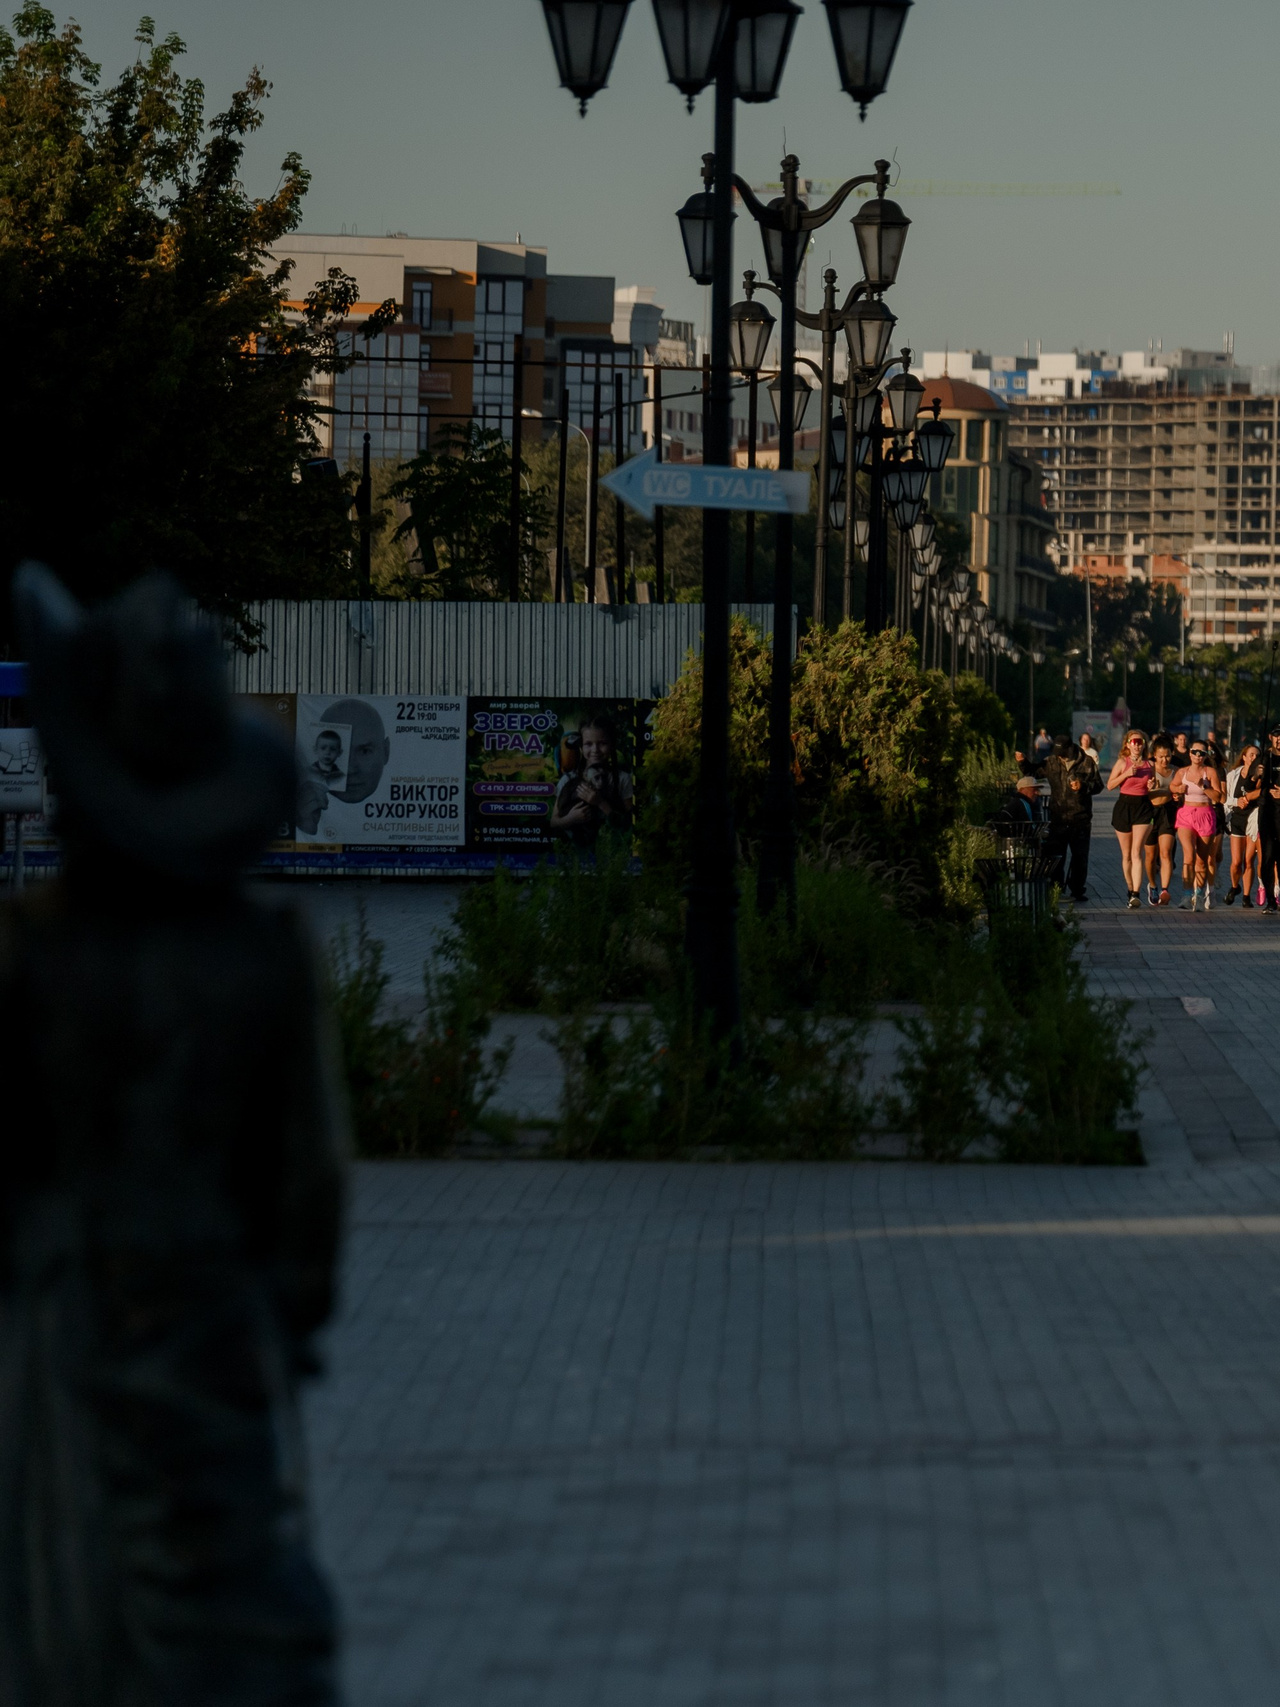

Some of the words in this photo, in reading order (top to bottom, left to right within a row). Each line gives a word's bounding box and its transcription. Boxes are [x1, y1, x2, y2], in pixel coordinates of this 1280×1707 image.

[648, 471, 689, 497] WC
[703, 475, 784, 501] ТУАЛЕ
[396, 702, 415, 720] 22
[417, 702, 460, 711] СЕНТЯБРЯ
[489, 702, 507, 710] мир
[509, 701, 540, 710] зверей
[417, 712, 437, 721] 19:00
[473, 711, 552, 732] ЗВЕРО
[395, 726, 423, 734] ДВОРЕЦ
[424, 726, 460, 734] КУЛЬТУРЫ
[484, 732, 544, 755] ГРАД
[390, 784, 459, 801] ВИКТОР
[365, 803, 459, 819] СУХОРУКОВ
[363, 822, 435, 832] СЧАСТЛИВЫЕ
[436, 823, 460, 834] ДНИ
